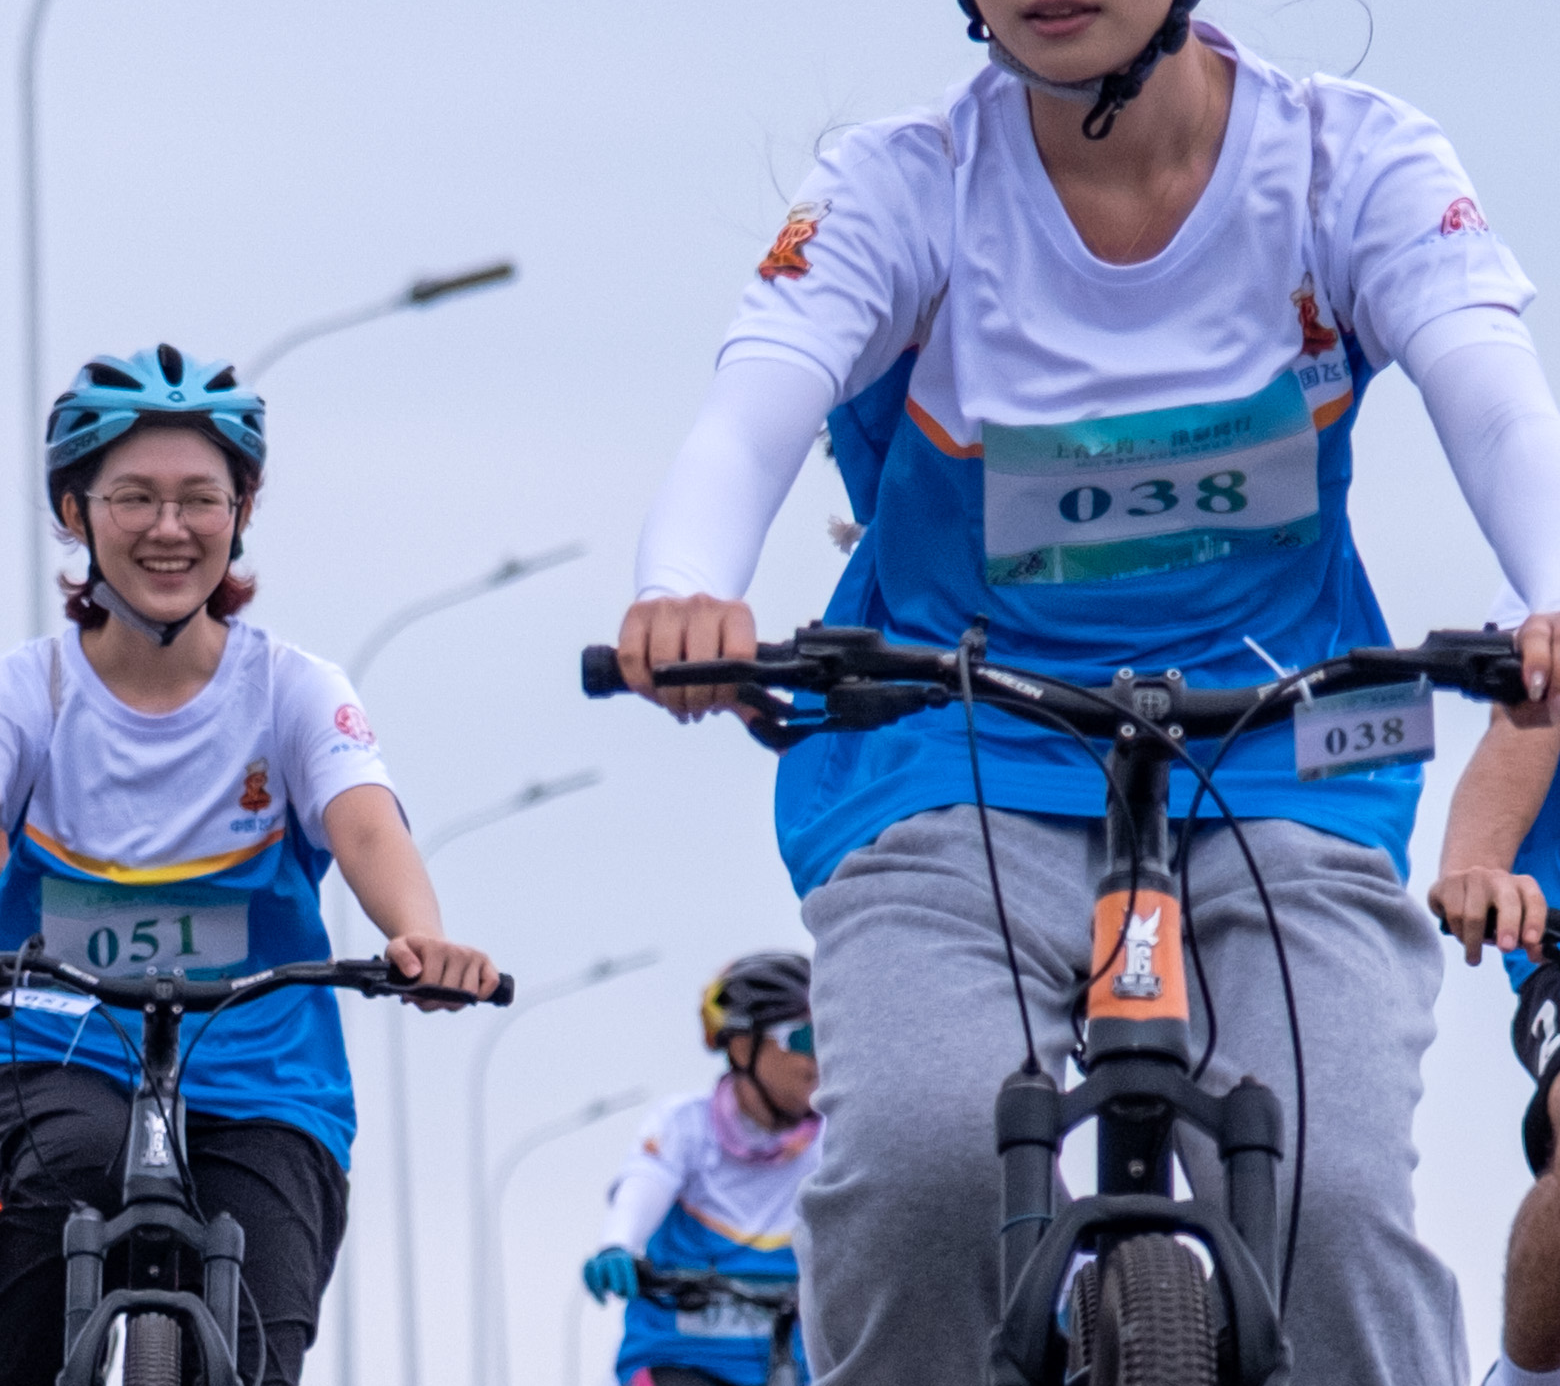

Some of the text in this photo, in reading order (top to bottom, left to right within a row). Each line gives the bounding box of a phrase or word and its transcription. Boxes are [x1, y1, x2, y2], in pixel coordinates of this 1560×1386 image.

[1059, 470, 1248, 523] 038
[1325, 717, 1405, 755] 038
[87, 914, 200, 968] 051
